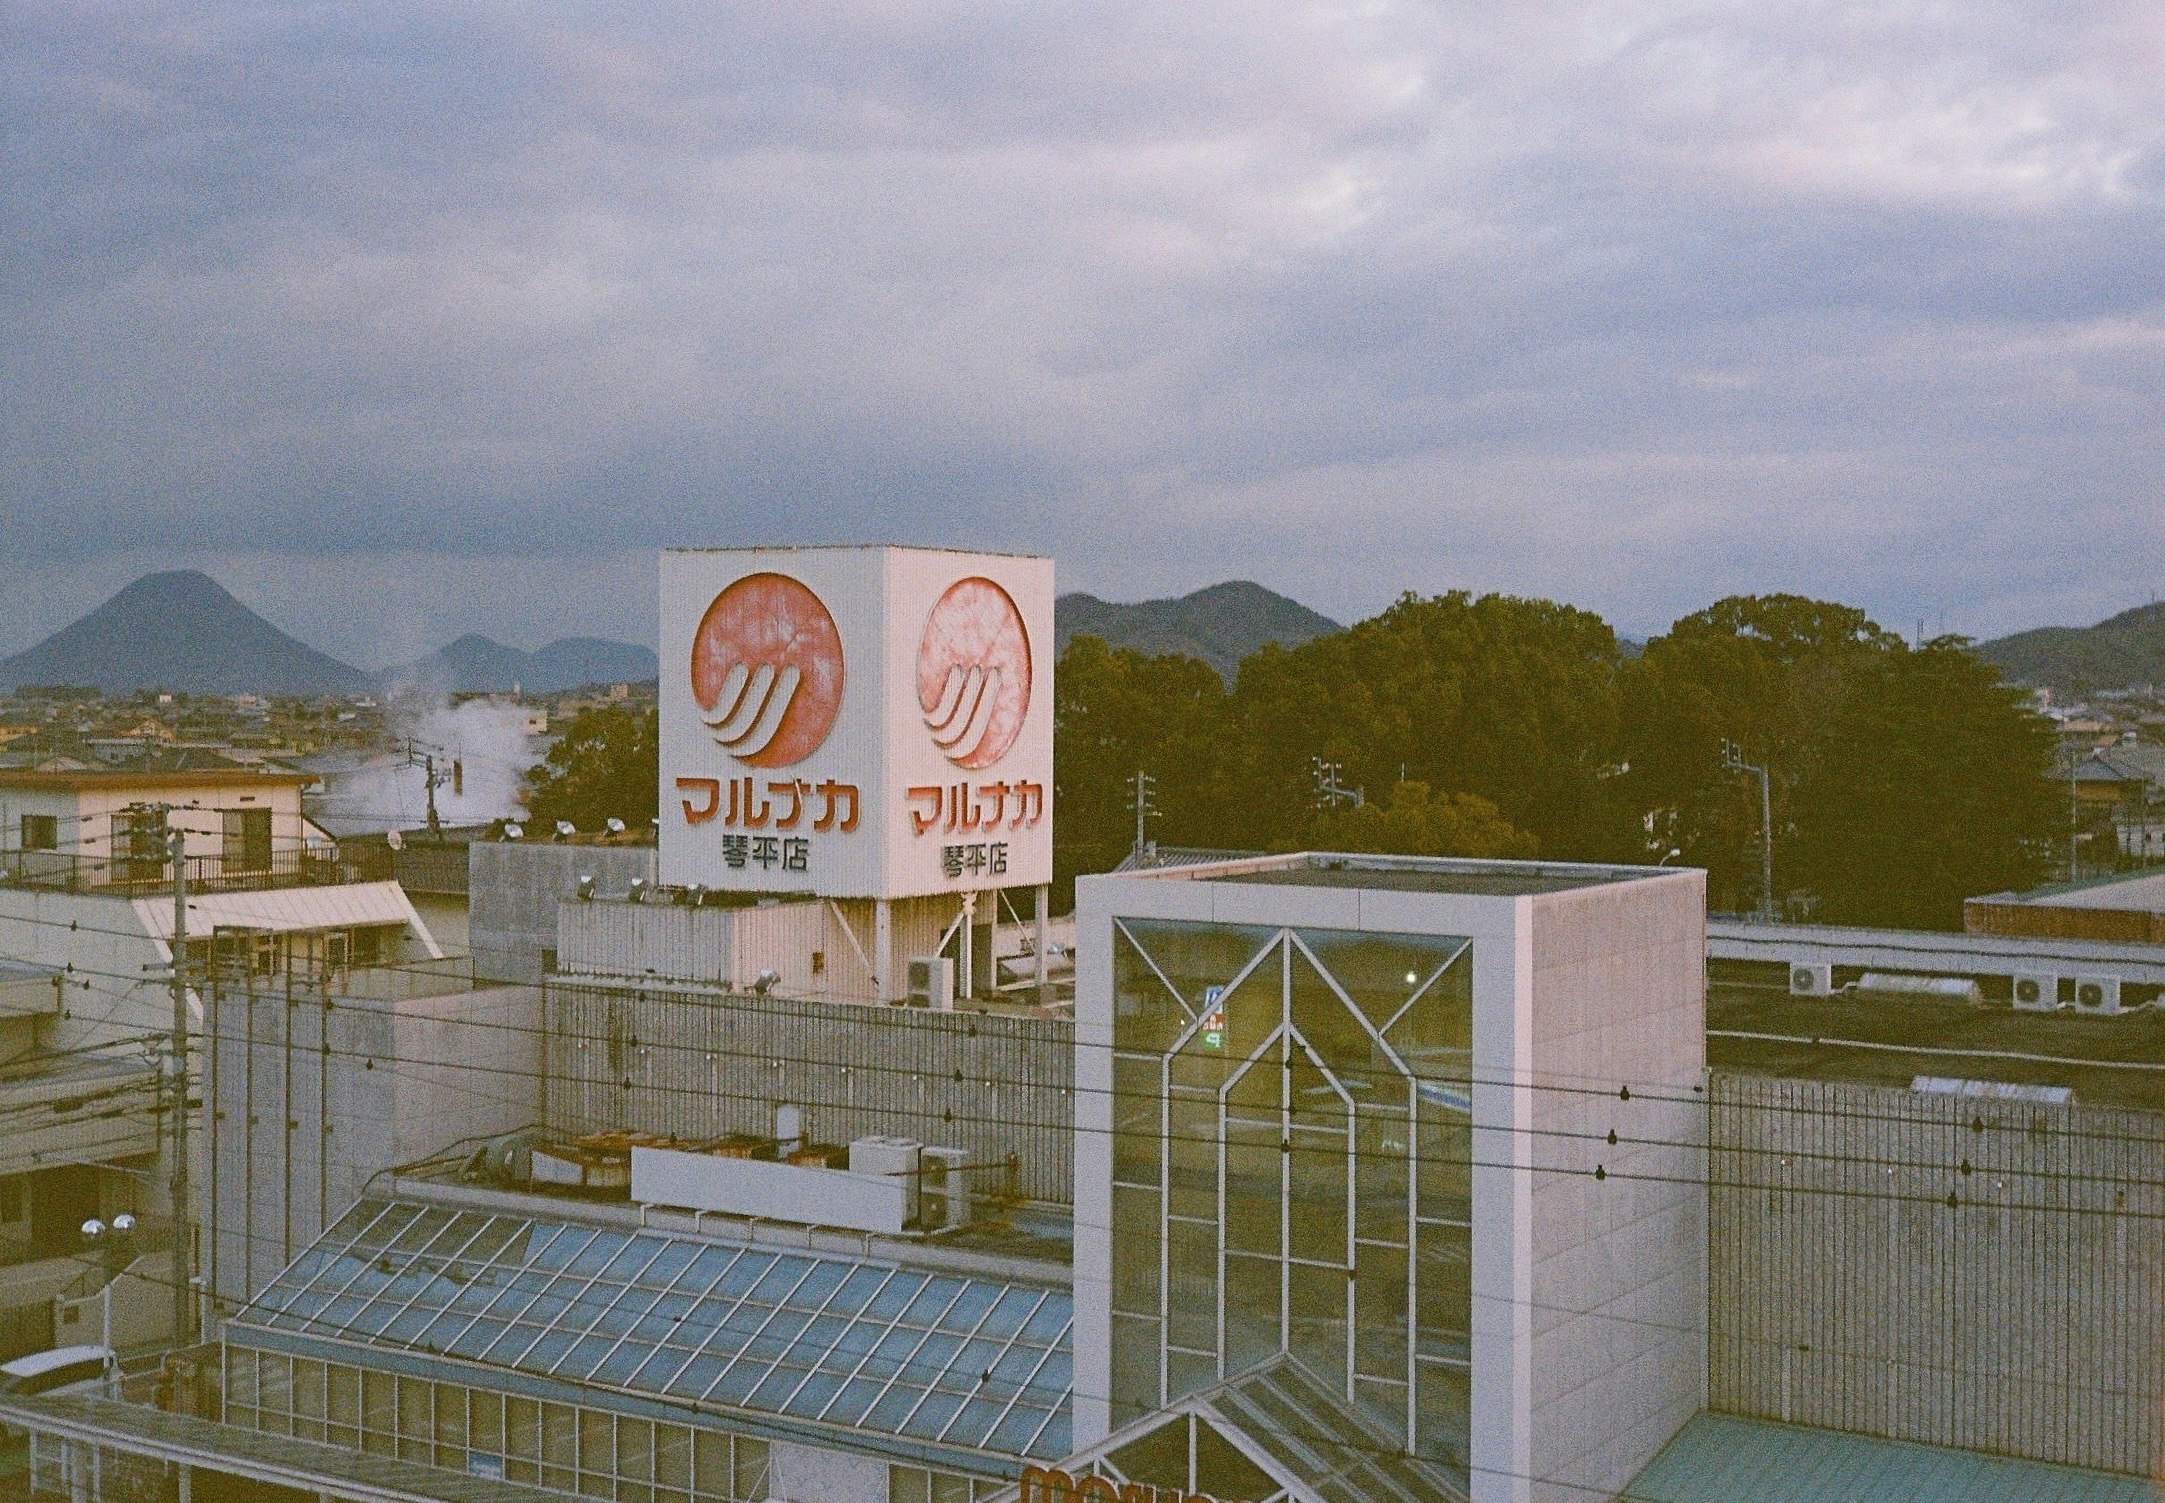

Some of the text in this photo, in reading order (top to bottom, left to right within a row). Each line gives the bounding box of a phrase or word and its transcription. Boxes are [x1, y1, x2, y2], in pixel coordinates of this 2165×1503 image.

[676, 776, 861, 832] マルナカ
[907, 780, 1043, 836] マルナカ
[722, 834, 810, 872] 琴平店
[942, 842, 1009, 878] 琴平店
